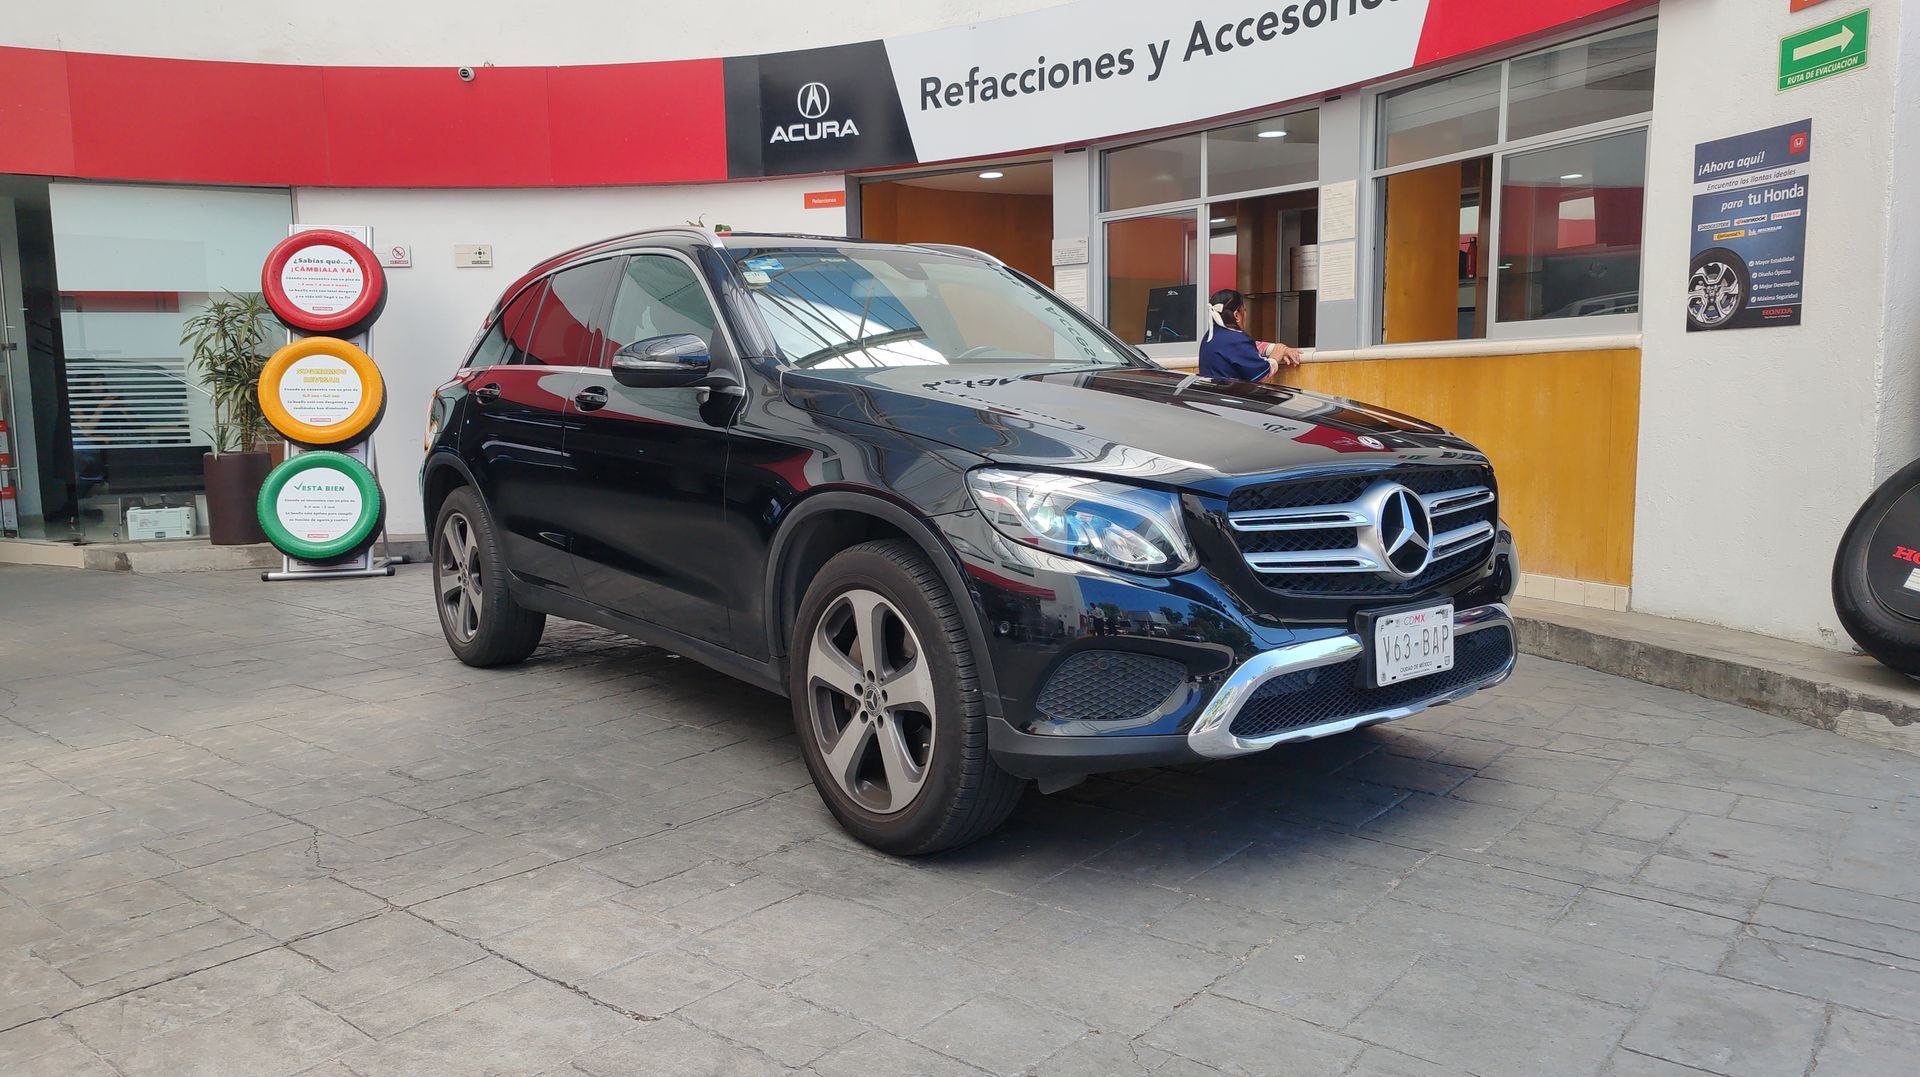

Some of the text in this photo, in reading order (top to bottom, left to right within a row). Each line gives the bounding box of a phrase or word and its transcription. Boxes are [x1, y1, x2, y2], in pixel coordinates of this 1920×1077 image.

[920, 0, 1399, 111] Refacciones y Accesor
[1787, 56, 1858, 85] RUTA DE EVACUACION
[770, 118, 860, 144] ACURA
[1698, 150, 1766, 176] ¡Ahora aquí!
[1706, 180, 1738, 191] Encuentra
[1750, 173, 1772, 183] llantas
[1774, 168, 1796, 179] ideales
[1721, 183, 1804, 212] para tu Honda
[1776, 293, 1798, 301] Seguridad
[1404, 614, 1425, 626] CDMX
[1382, 624, 1449, 665] V63-BAP
[1400, 665, 1413, 673] CIUDAD
